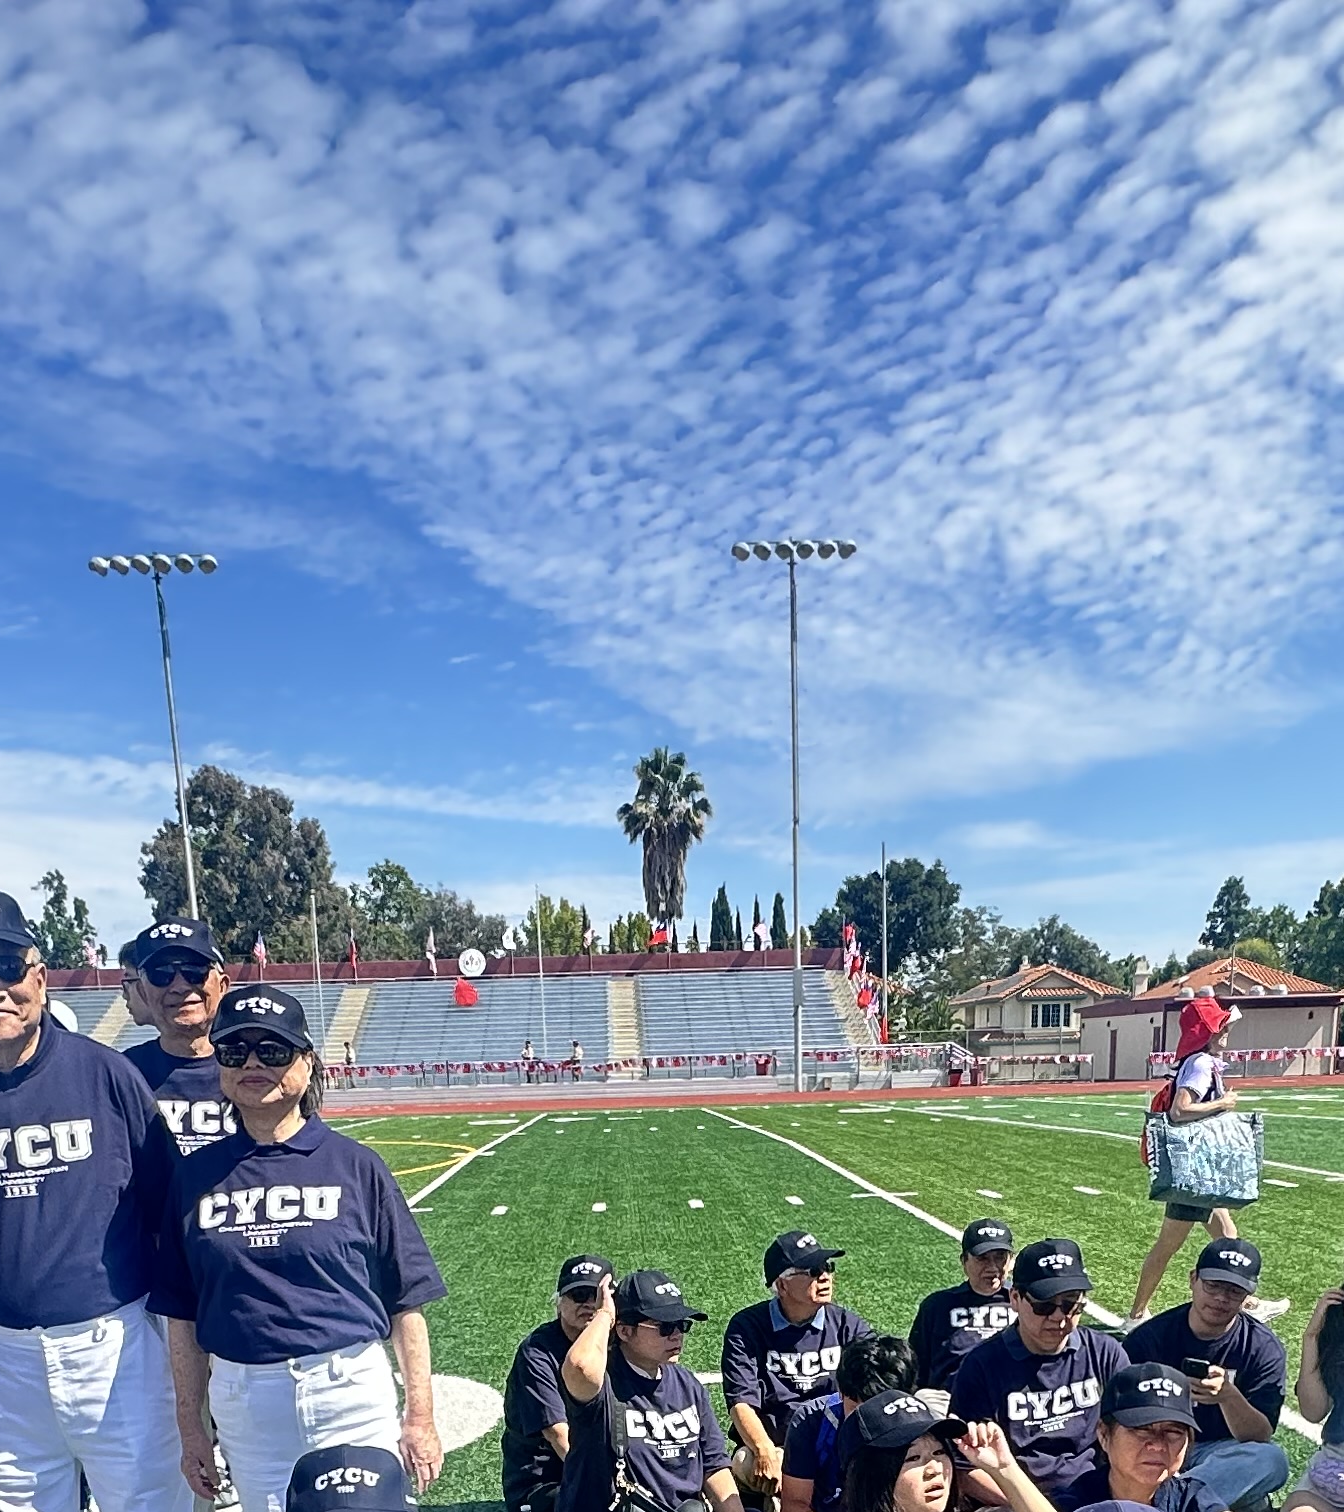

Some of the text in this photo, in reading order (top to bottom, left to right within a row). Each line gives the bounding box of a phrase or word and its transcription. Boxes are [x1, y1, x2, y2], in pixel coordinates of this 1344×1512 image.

[198, 1185, 342, 1229] CYCU
[766, 1345, 842, 1376] CYCU
[1007, 1377, 1101, 1421] CYCU
[625, 1404, 701, 1440] CYCU
[314, 1467, 380, 1491] CYCU
